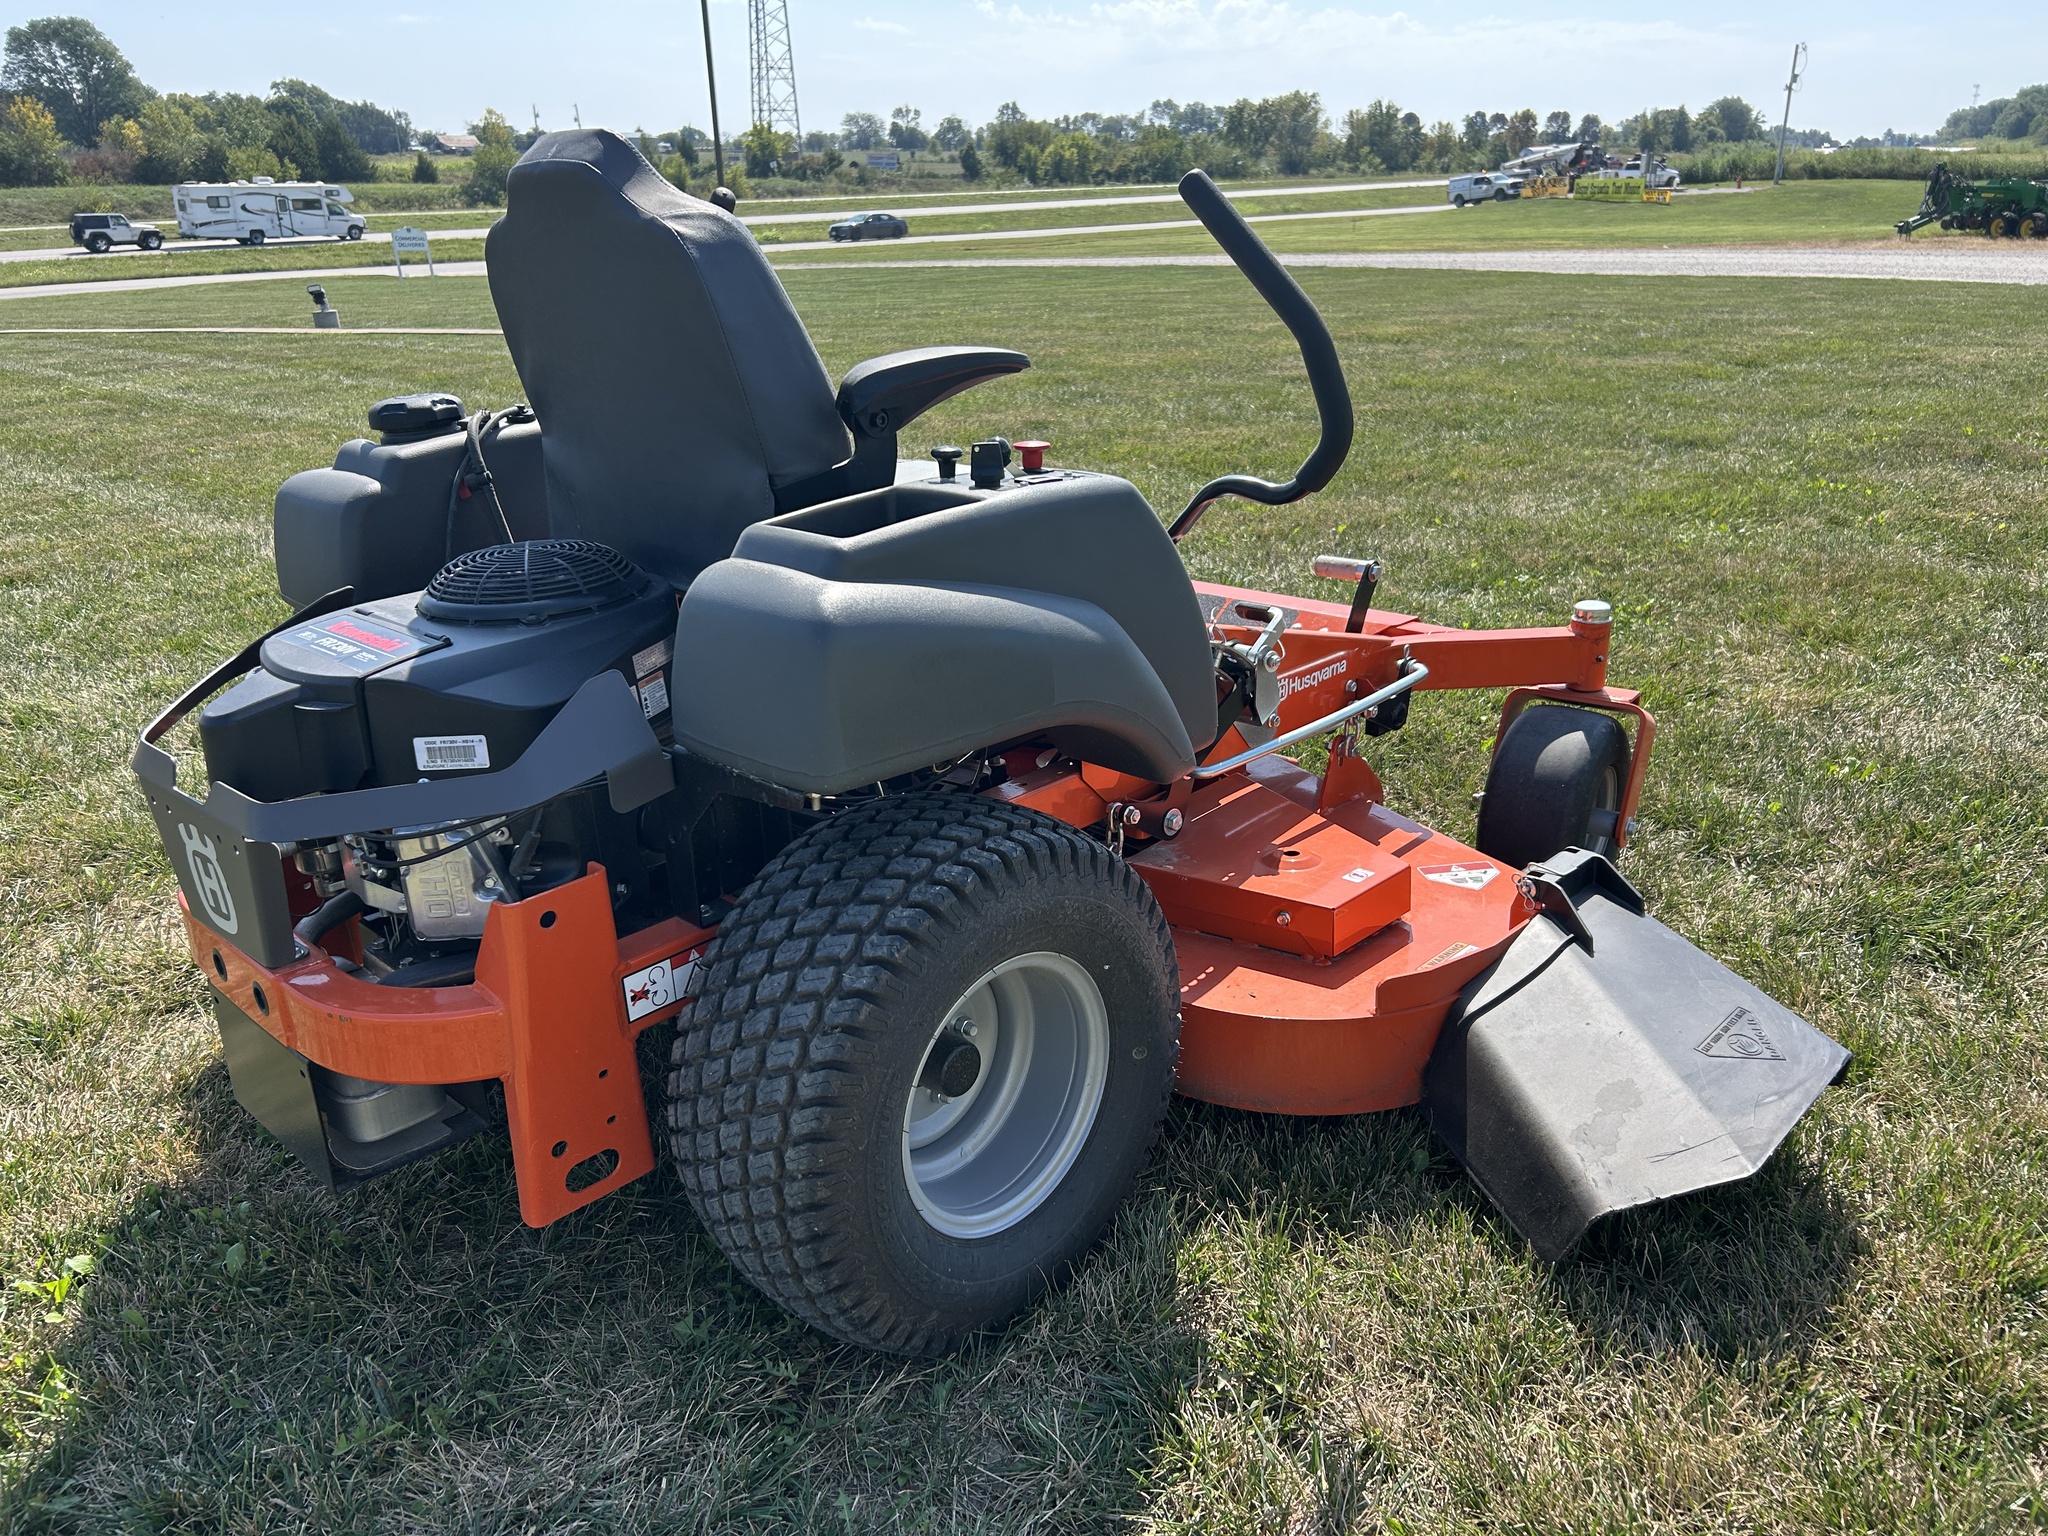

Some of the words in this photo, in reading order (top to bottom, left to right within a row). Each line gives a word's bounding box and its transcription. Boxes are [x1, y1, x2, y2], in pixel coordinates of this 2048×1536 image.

[325, 621, 410, 652] Kawasaki
[1288, 659, 1347, 695] Husqvarna
[418, 859, 453, 919] OHV
[1427, 943, 1464, 966] WARNING
